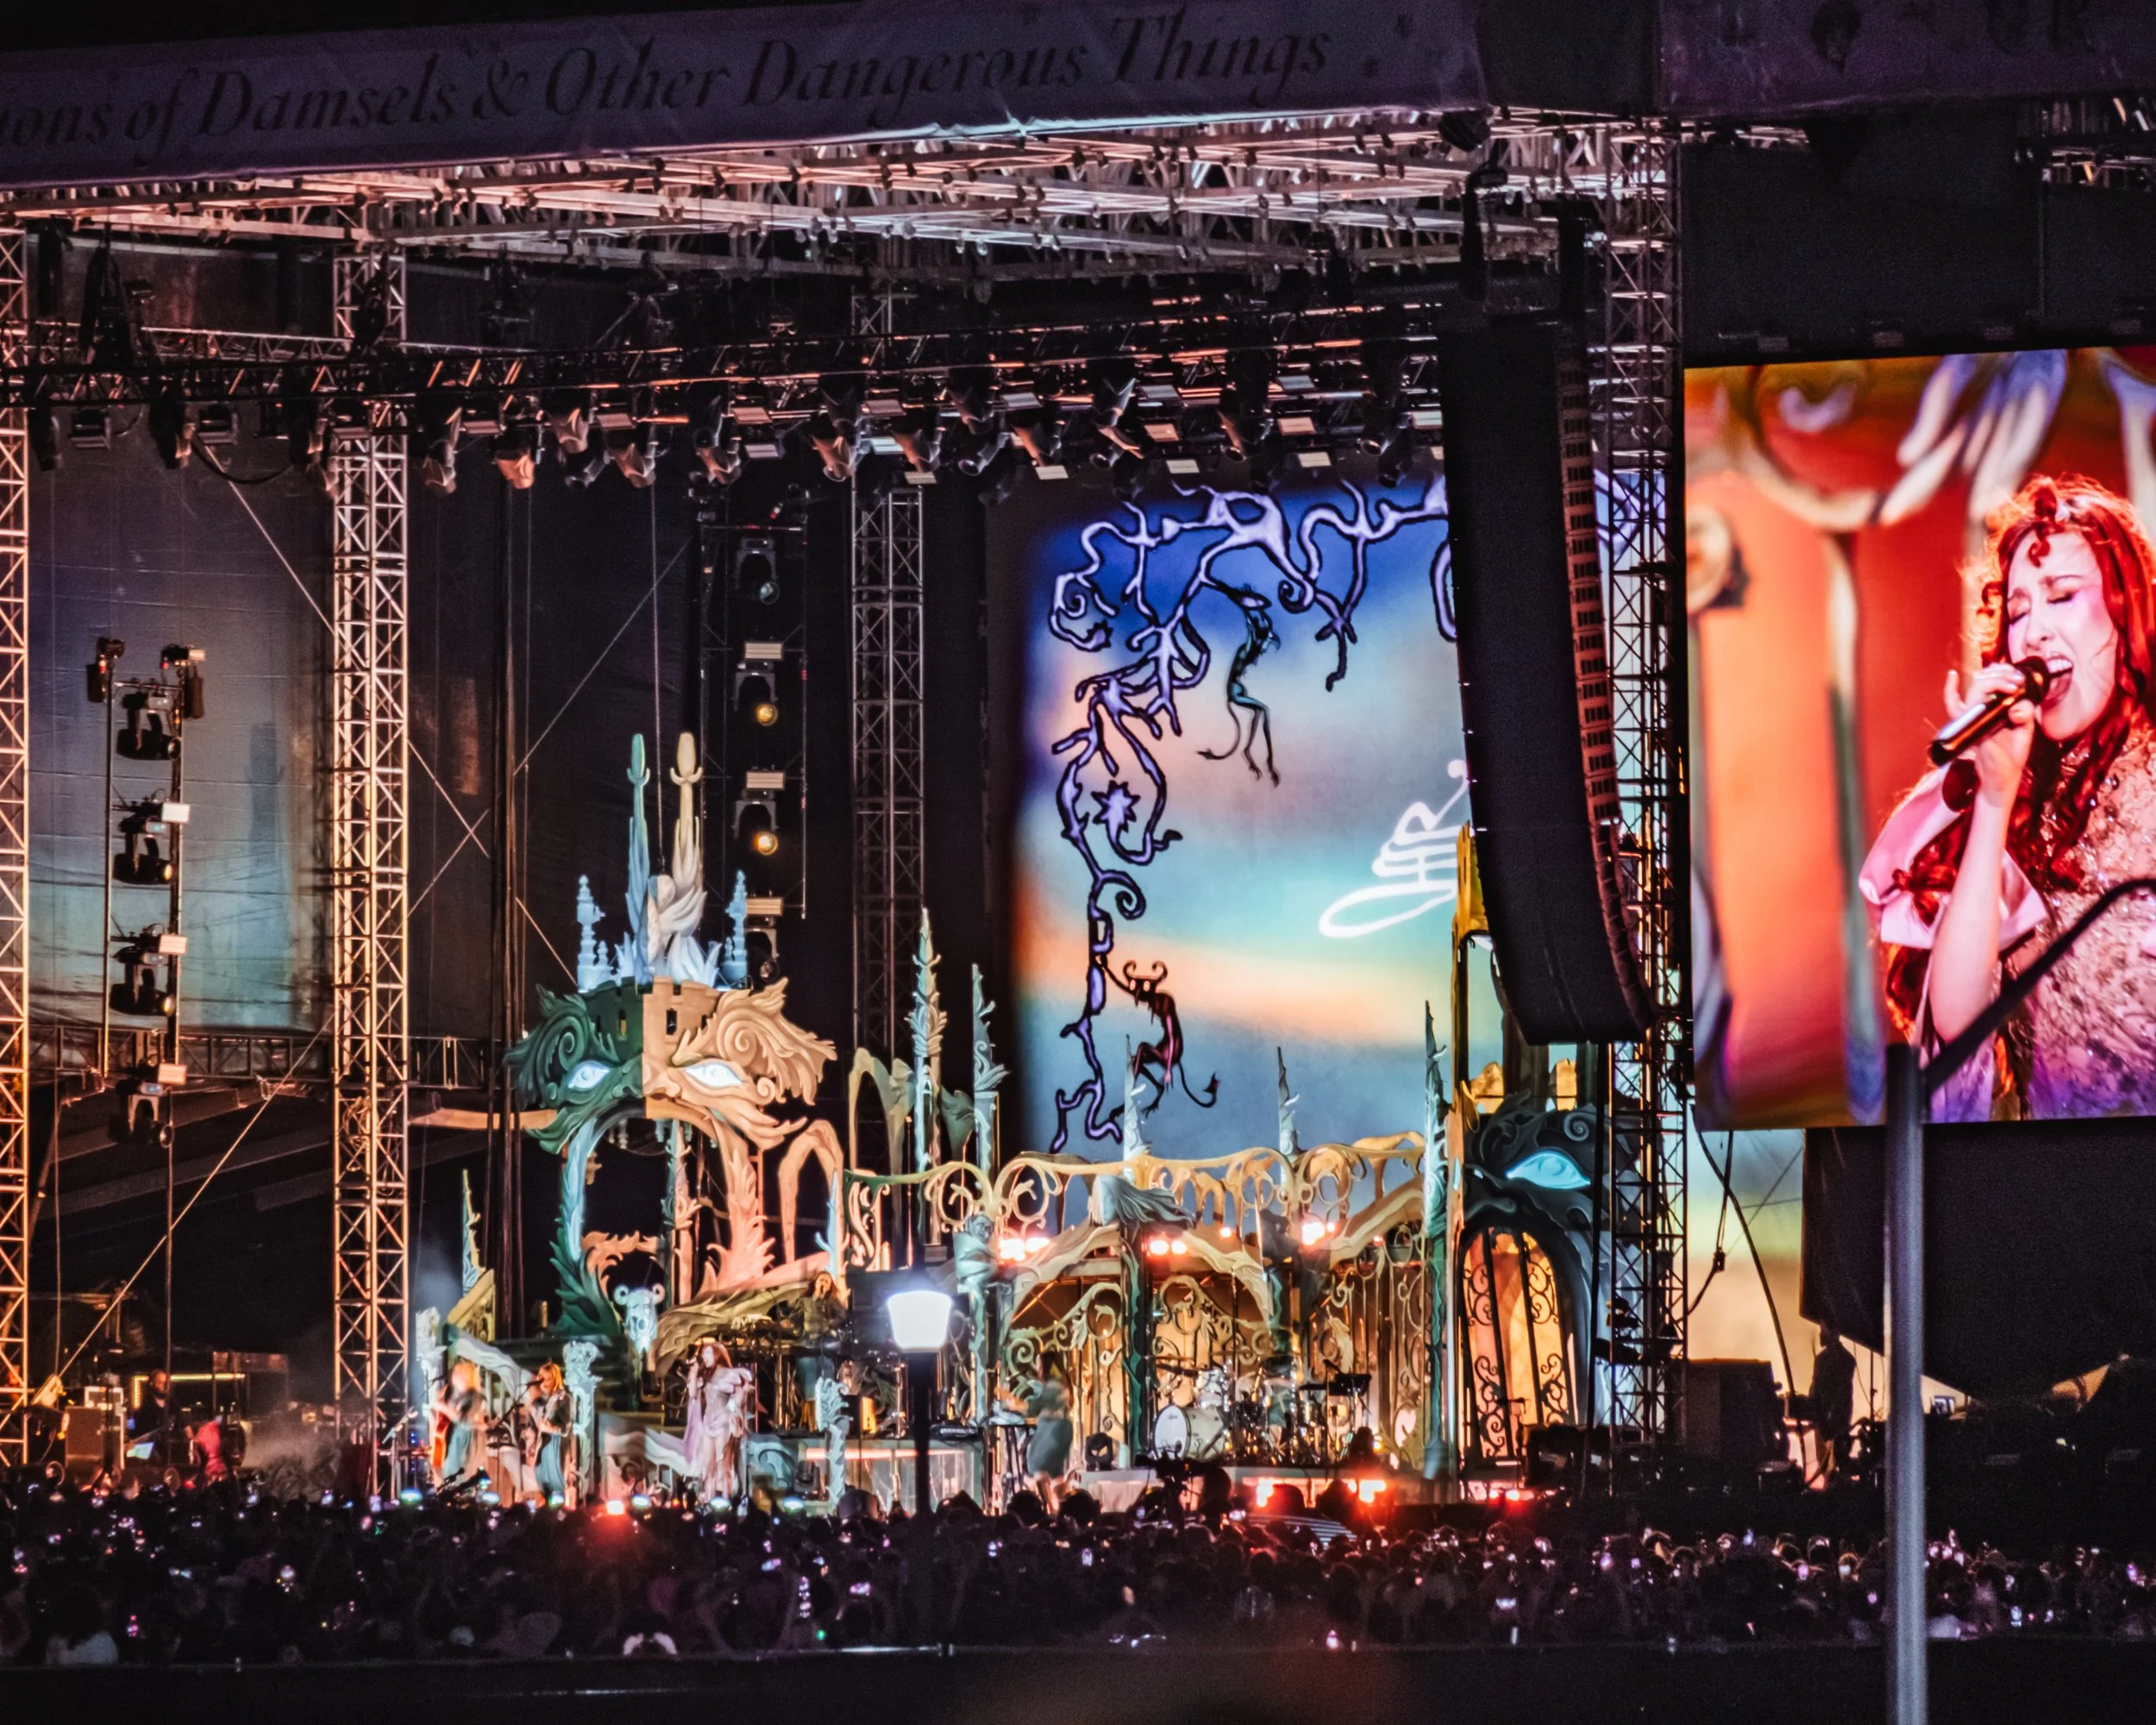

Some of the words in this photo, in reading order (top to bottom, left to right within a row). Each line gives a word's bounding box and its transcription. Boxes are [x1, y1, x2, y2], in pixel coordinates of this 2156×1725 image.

[126, 68, 199, 165] of
[194, 54, 455, 136] Damsels
[472, 59, 530, 119] &
[545, 34, 728, 116] Other
[742, 39, 1087, 128] Dangerous
[1106, 4, 1330, 108] Things
